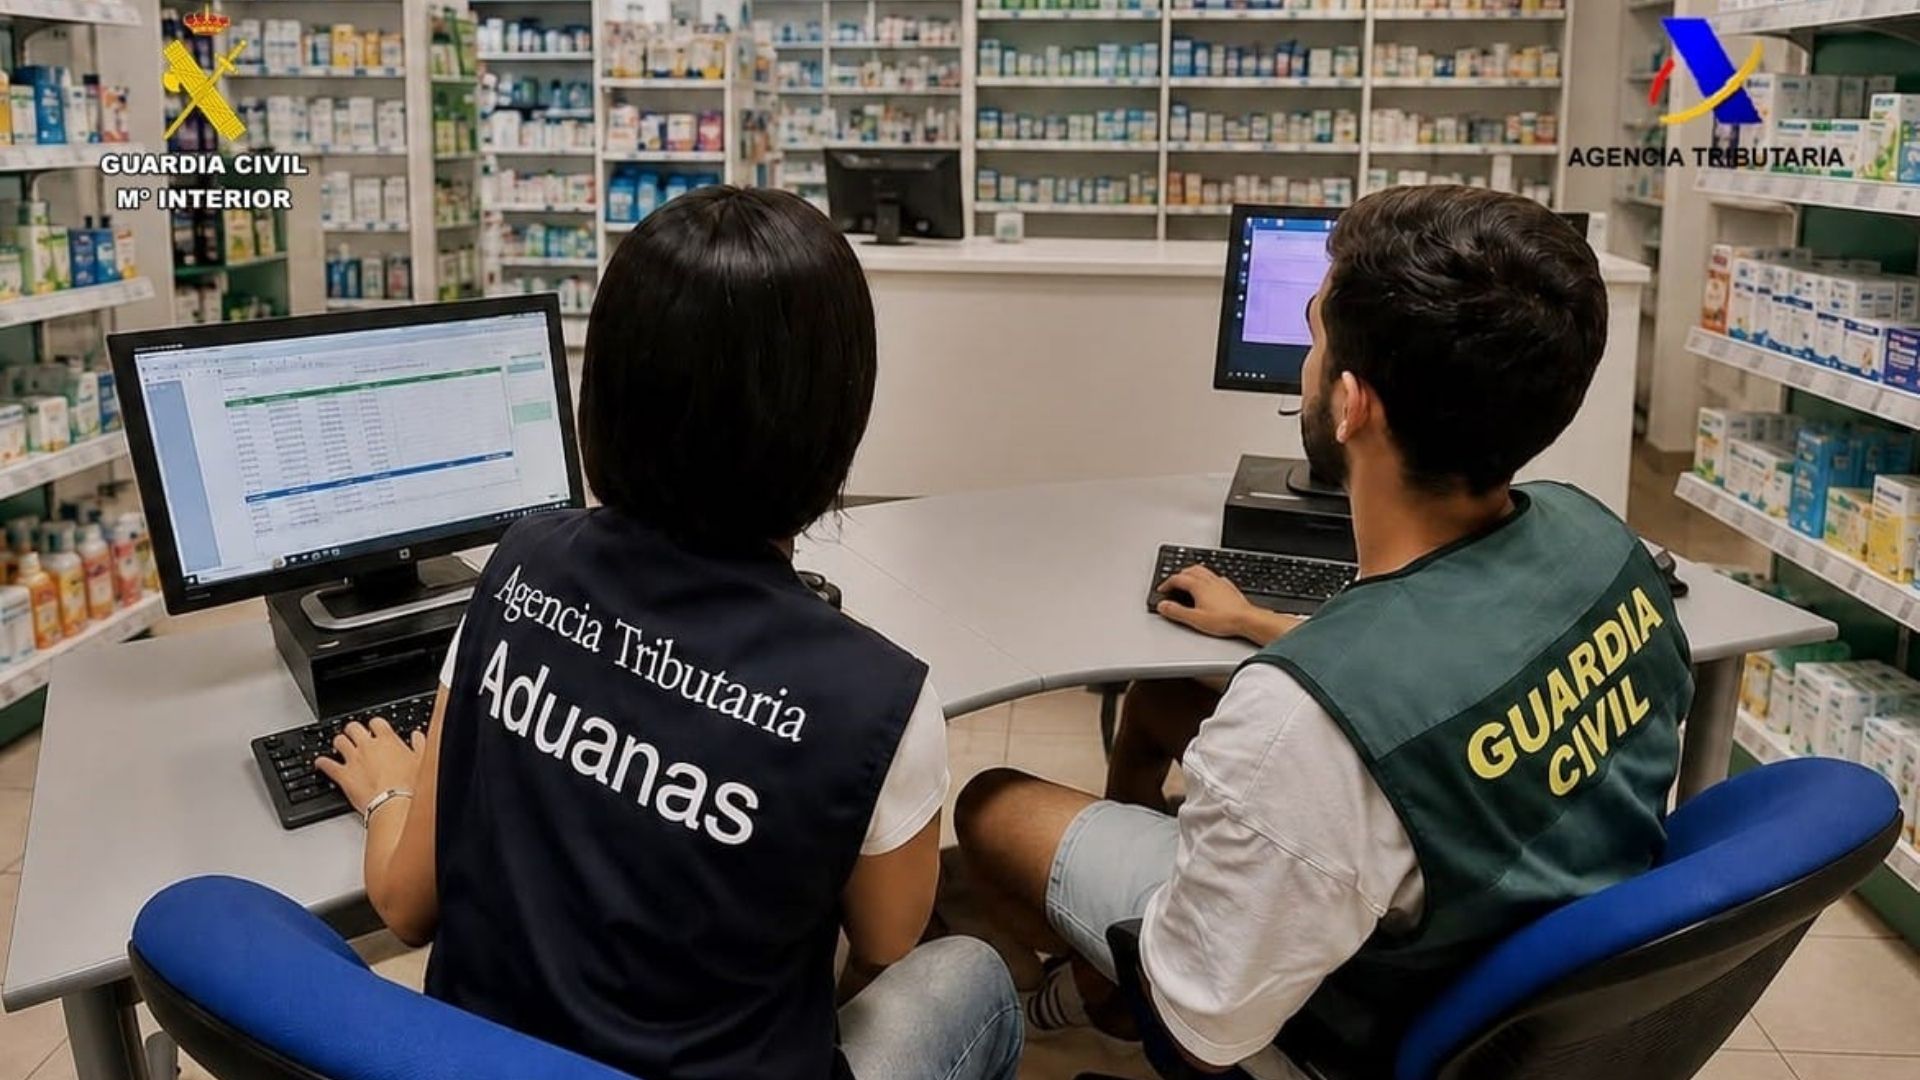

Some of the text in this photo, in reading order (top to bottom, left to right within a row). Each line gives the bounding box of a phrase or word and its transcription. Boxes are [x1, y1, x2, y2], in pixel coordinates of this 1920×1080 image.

[478, 639, 760, 846] Aduanas
[493, 564, 808, 743] Agencia Tributaria
[1467, 586, 1663, 780] GUARDIA
[1547, 675, 1651, 797] CIVIL
